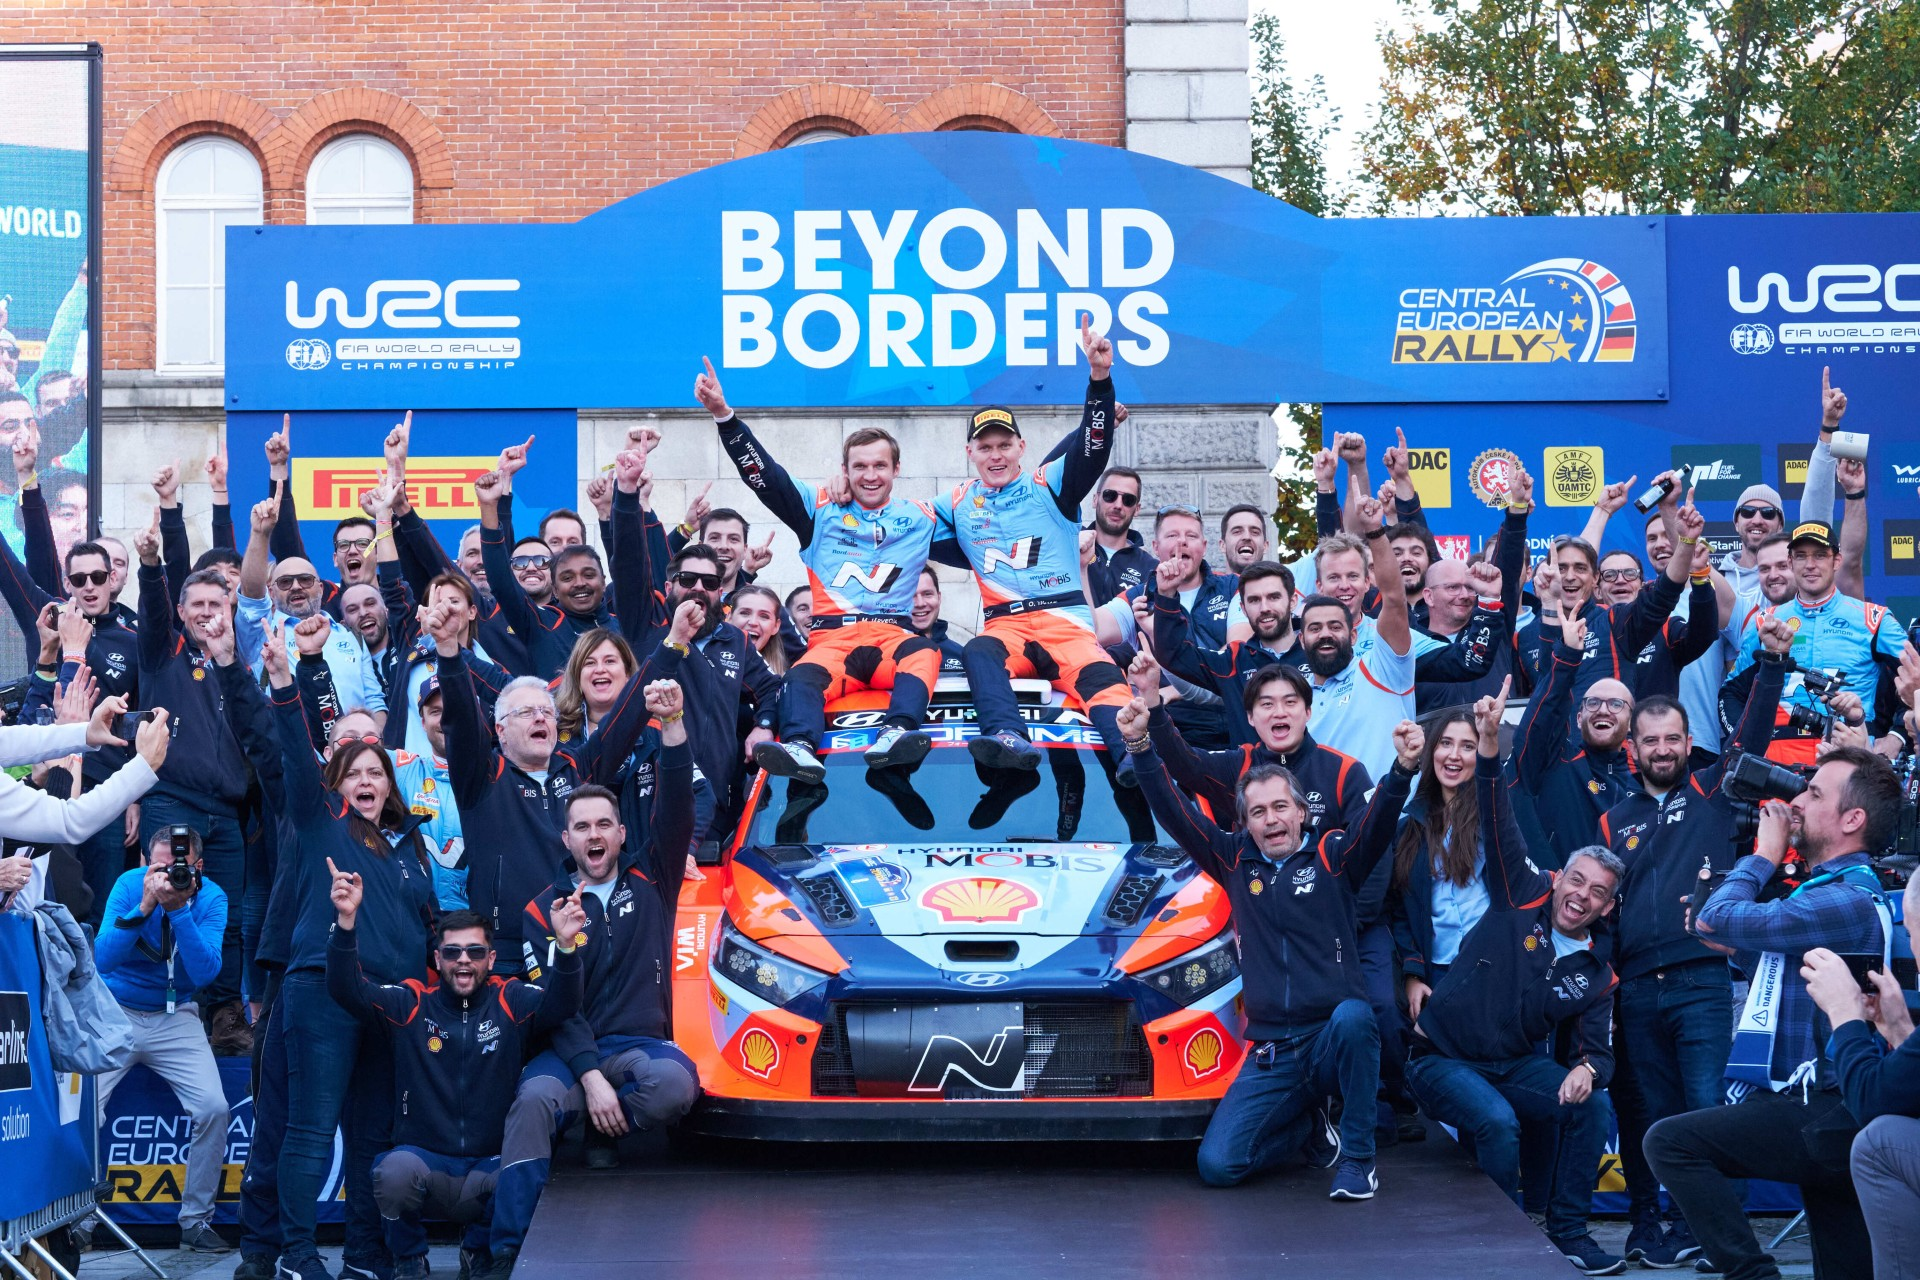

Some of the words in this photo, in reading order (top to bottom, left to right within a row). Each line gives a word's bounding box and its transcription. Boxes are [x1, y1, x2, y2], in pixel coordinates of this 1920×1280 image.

[721, 207, 1175, 291] BEYOND
[286, 279, 521, 329] WRC
[1400, 288, 1536, 308] CENTRAL
[721, 290, 1171, 369] BORDERS
[1396, 310, 1564, 331] EUROPEAN
[1785, 328, 1812, 338] FIA
[1818, 327, 1885, 337] WORLD
[341, 344, 369, 353] FIA
[375, 344, 443, 353] WORLD
[449, 343, 515, 353] RALLY
[1393, 334, 1546, 362] RALLY
[341, 361, 515, 371] CHAMPIONSHIP
[1091, 410, 1106, 450] MOBIS
[745, 441, 765, 471] HYUNDAI
[1408, 450, 1447, 470] DAC
[1562, 451, 1584, 461] AMF
[1786, 461, 1807, 469] ADAC
[738, 453, 766, 489] MOBIS
[1005, 493, 1034, 508] HYUNDAI
[1892, 537, 1913, 545] ADAC
[1038, 573, 1072, 590] MOBIS
[1823, 628, 1854, 637] HYUNDAI
[1909, 780, 1919, 800] EOS
[925, 853, 1106, 872] MOBIS
[696, 913, 706, 950] HYUNDAI
[1762, 956, 1779, 1007] DANGEROUS
[1, 1104, 30, 1142] solution
